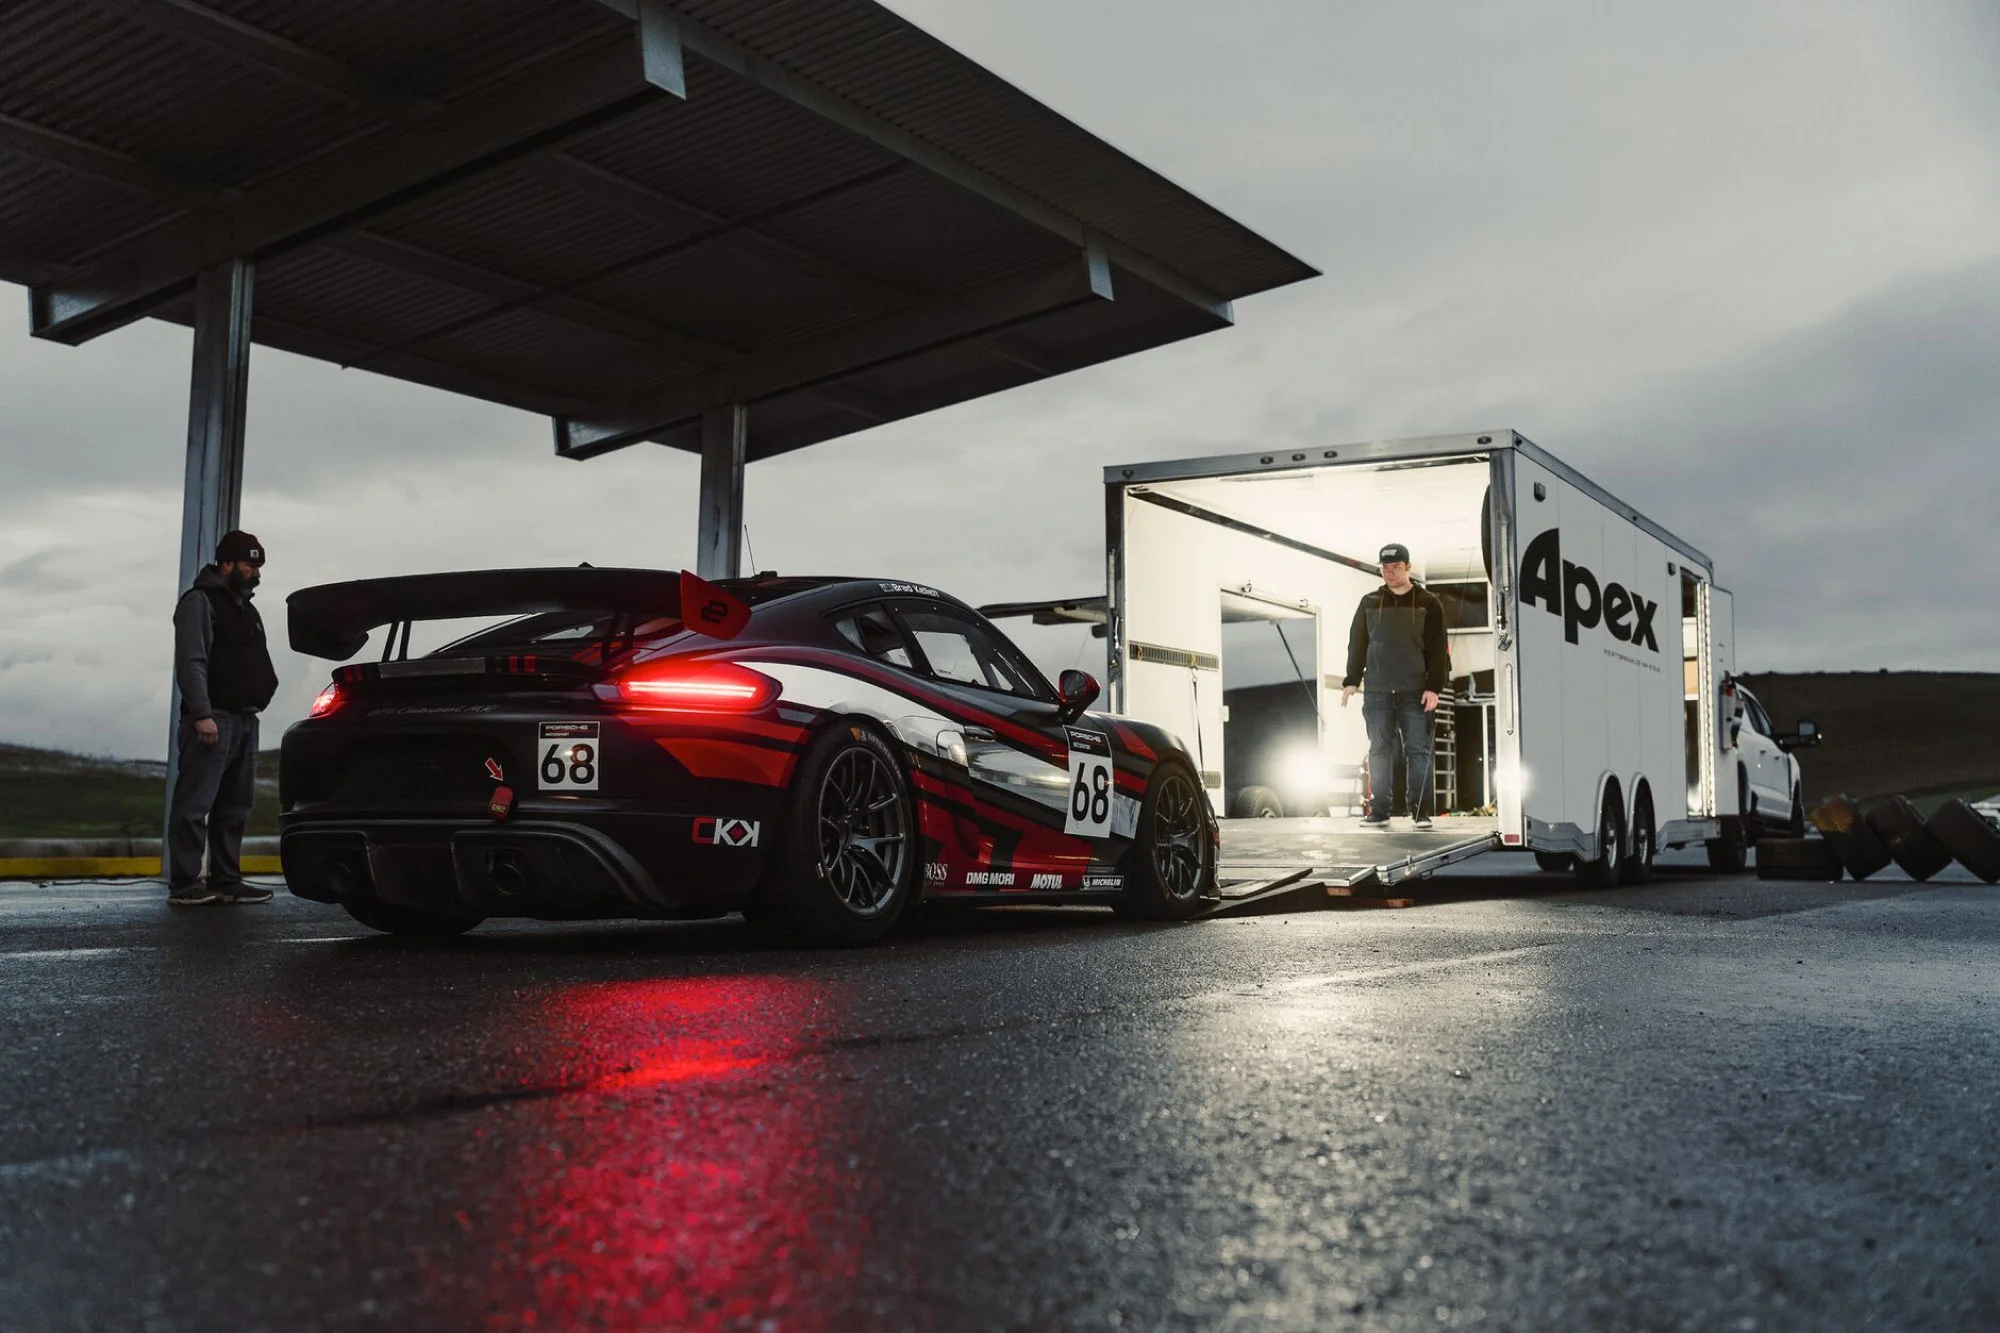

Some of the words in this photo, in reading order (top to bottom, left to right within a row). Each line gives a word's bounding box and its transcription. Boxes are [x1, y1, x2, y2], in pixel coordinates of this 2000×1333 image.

[1519, 528, 1659, 653] Apex
[541, 744, 595, 785] 68
[1072, 762, 1109, 825] 68
[965, 872, 989, 885] DMG
[989, 872, 1015, 885] MORI
[1030, 873, 1063, 889] MOTUL
[1092, 878, 1122, 886] MICHELIN
